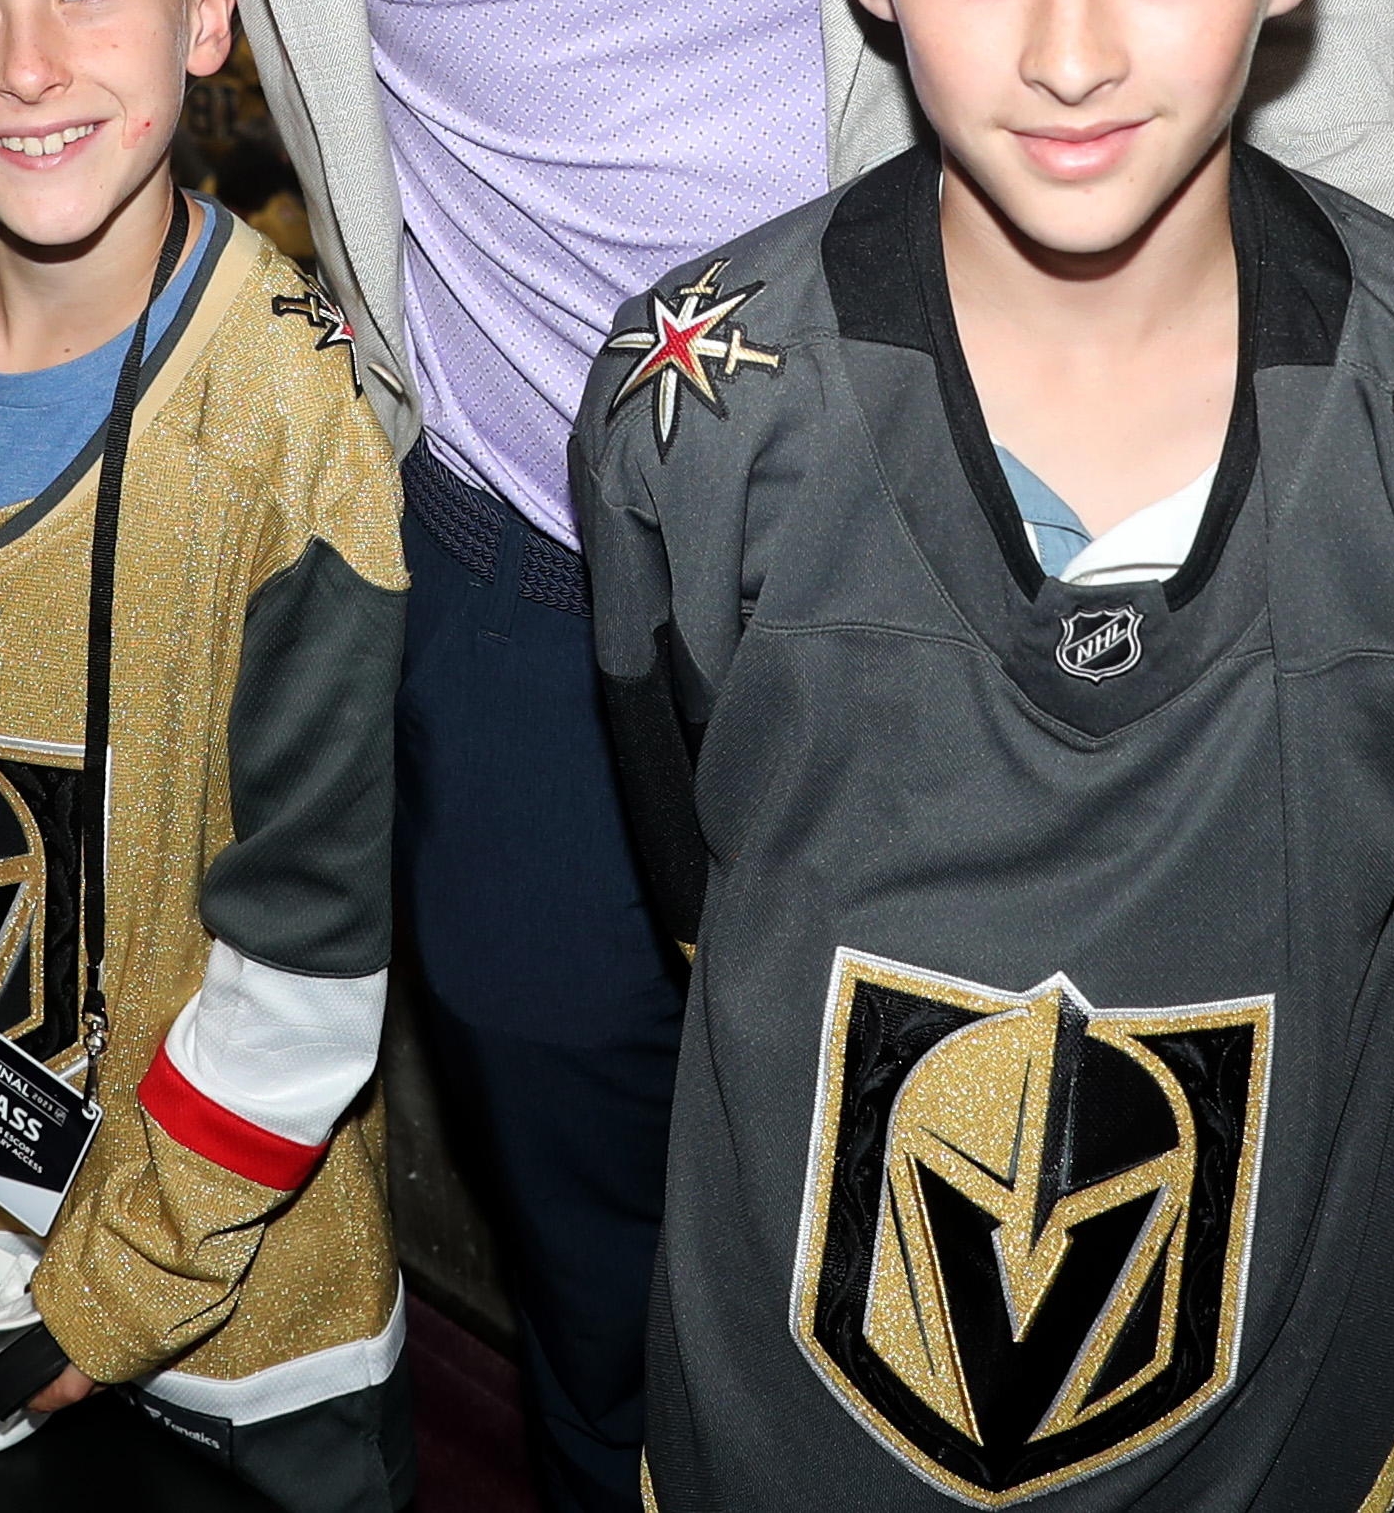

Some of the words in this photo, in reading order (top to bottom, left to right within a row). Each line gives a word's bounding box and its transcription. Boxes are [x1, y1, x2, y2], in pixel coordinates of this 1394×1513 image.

[1075, 620, 1128, 664] NHL
[31, 1092, 54, 1112] 2023
[3, 1130, 36, 1158] ESCORT
[11, 1147, 43, 1174] ACCESS
[163, 1416, 221, 1450] Fanatics
